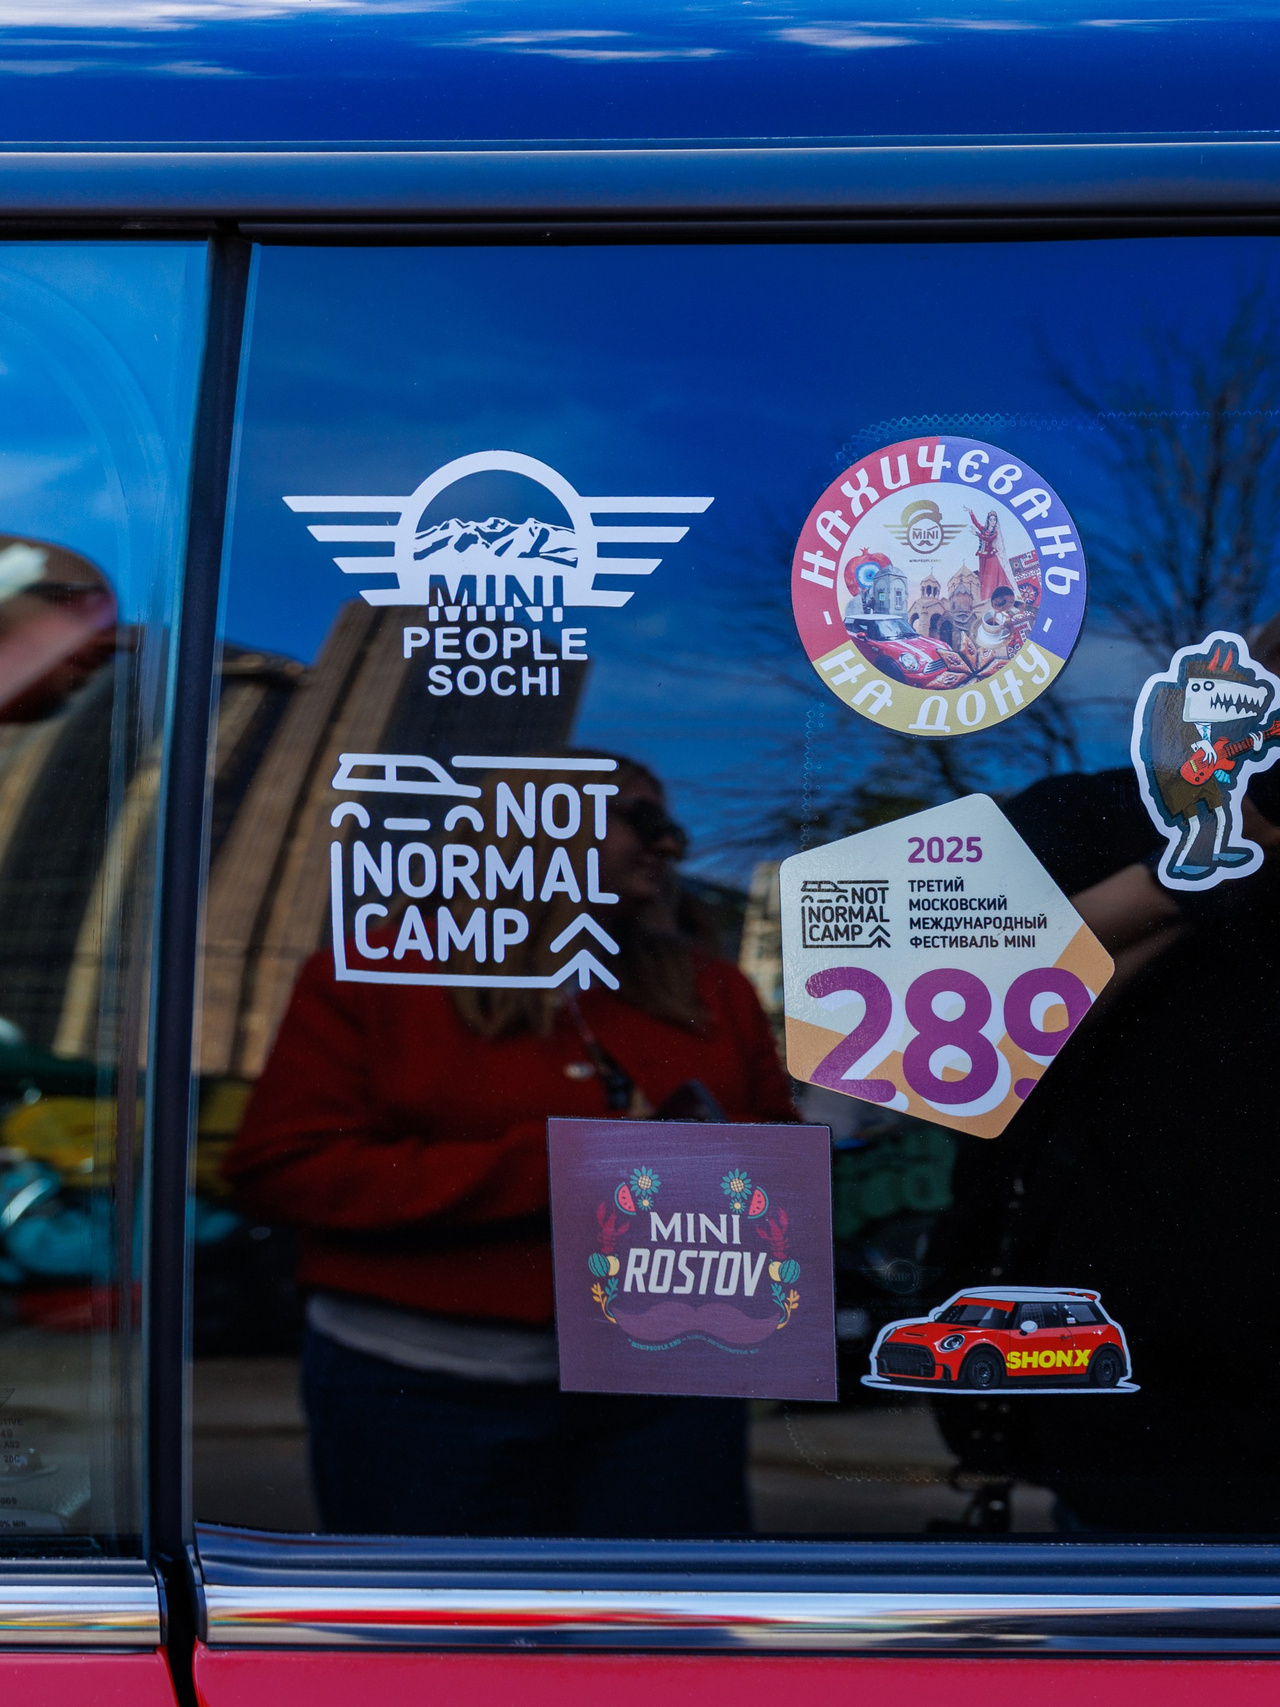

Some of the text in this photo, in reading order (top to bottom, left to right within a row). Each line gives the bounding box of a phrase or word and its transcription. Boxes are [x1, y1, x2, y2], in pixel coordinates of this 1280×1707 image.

[912, 530, 939, 540] MINI
[428, 574, 564, 622] MINI
[403, 626, 588, 660] PEOPLE
[427, 665, 560, 696] SOCHI
[819, 643, 1050, 732] НА ДОНУ
[496, 782, 619, 840] NOT
[907, 836, 983, 864] 2025
[353, 841, 619, 904] NORMAL
[908, 876, 965, 893] ТРЕТИЙ
[851, 887, 889, 905] NOT
[909, 895, 1008, 911] МОСКОВСКИЙ
[808, 906, 890, 923] NORMAL
[909, 913, 1048, 931] МЕЖДУНАРОДНЫЙ
[354, 903, 529, 963] CAMP
[808, 924, 863, 942] CAMP
[909, 935, 1036, 949] ФЕСТИВАЛЬ MINI
[805, 966, 1093, 1105] 289
[650, 1211, 741, 1244] MINI
[623, 1248, 767, 1297] ROSTOV
[1005, 1349, 1091, 1369] SHONX
